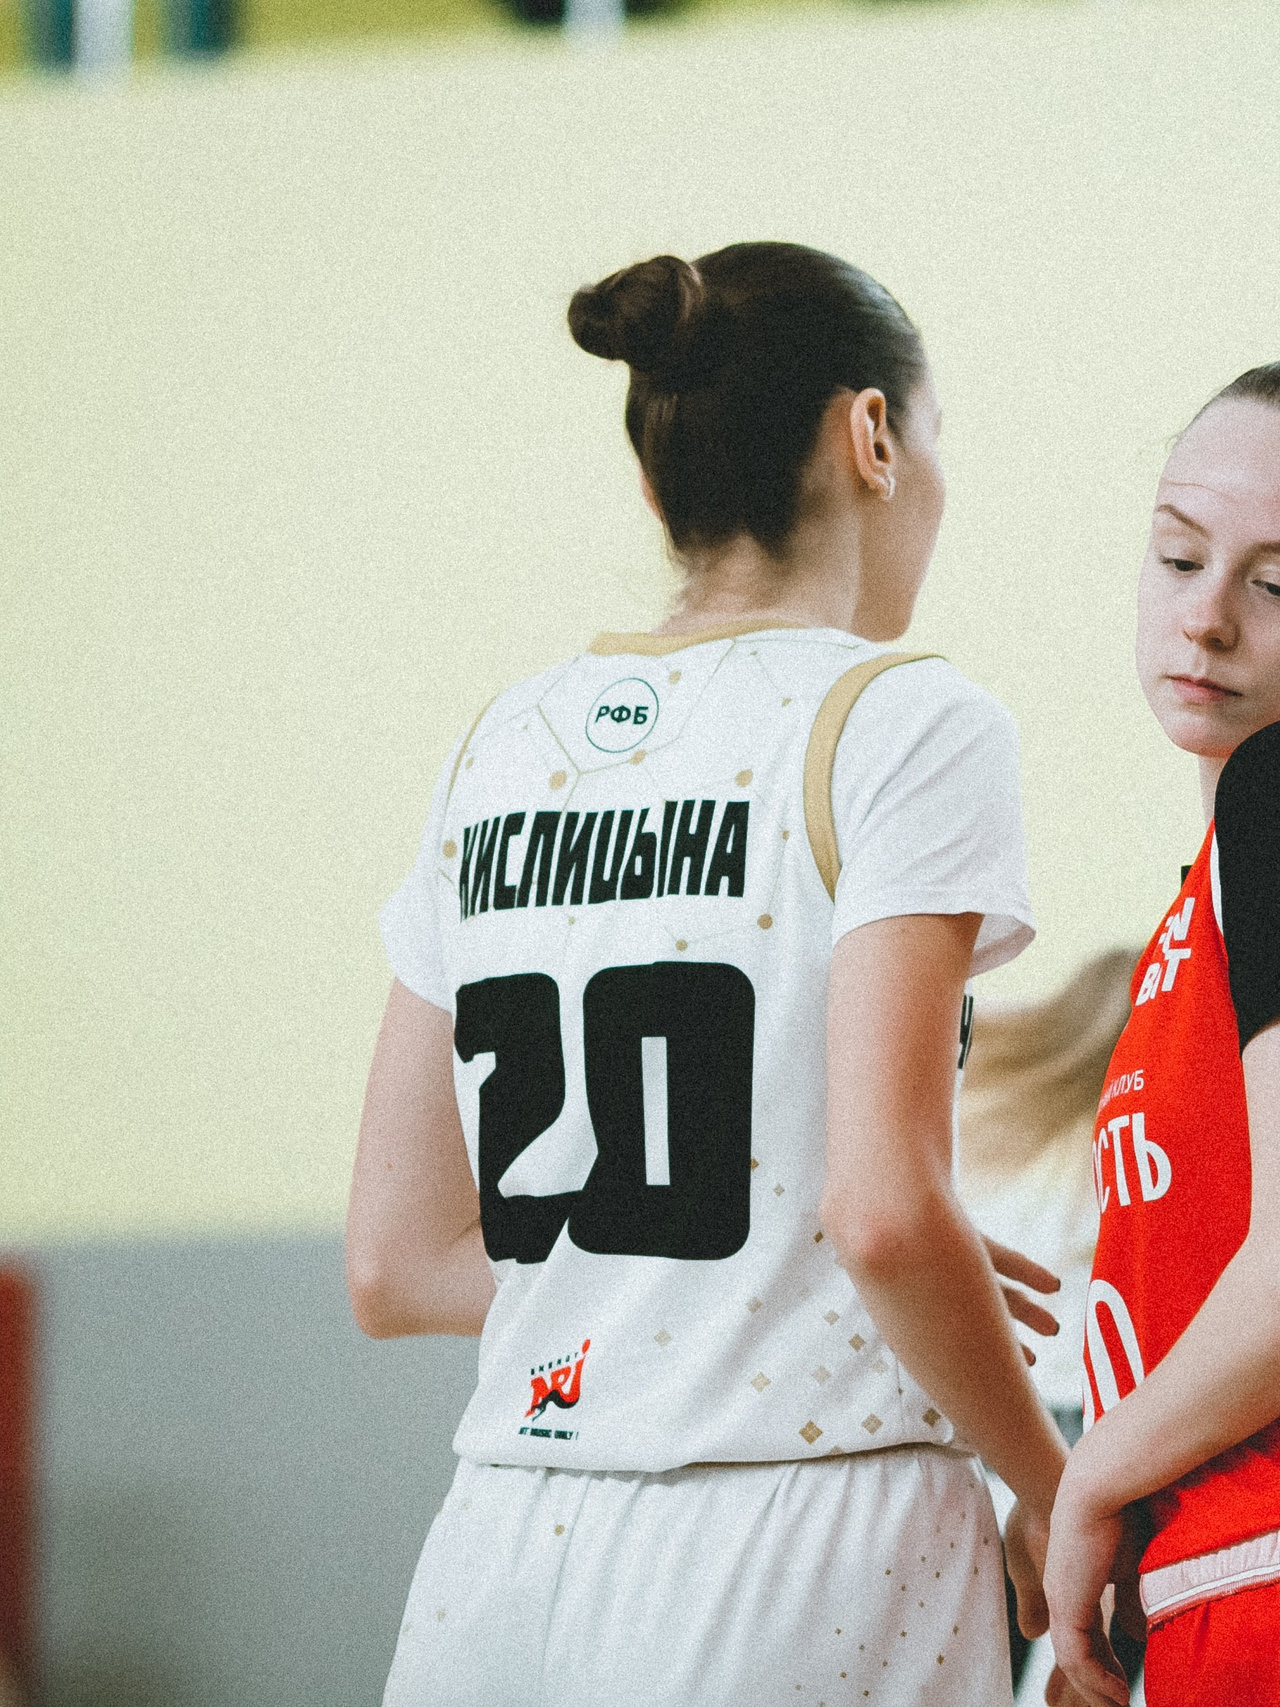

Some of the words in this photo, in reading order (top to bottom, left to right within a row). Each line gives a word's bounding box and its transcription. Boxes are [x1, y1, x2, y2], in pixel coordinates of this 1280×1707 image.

[595, 705, 649, 725] РФБ
[458, 799, 750, 923] КИСЛИЦЫНА
[453, 960, 756, 1265] 20
[1082, 1278, 1146, 1435] 0
